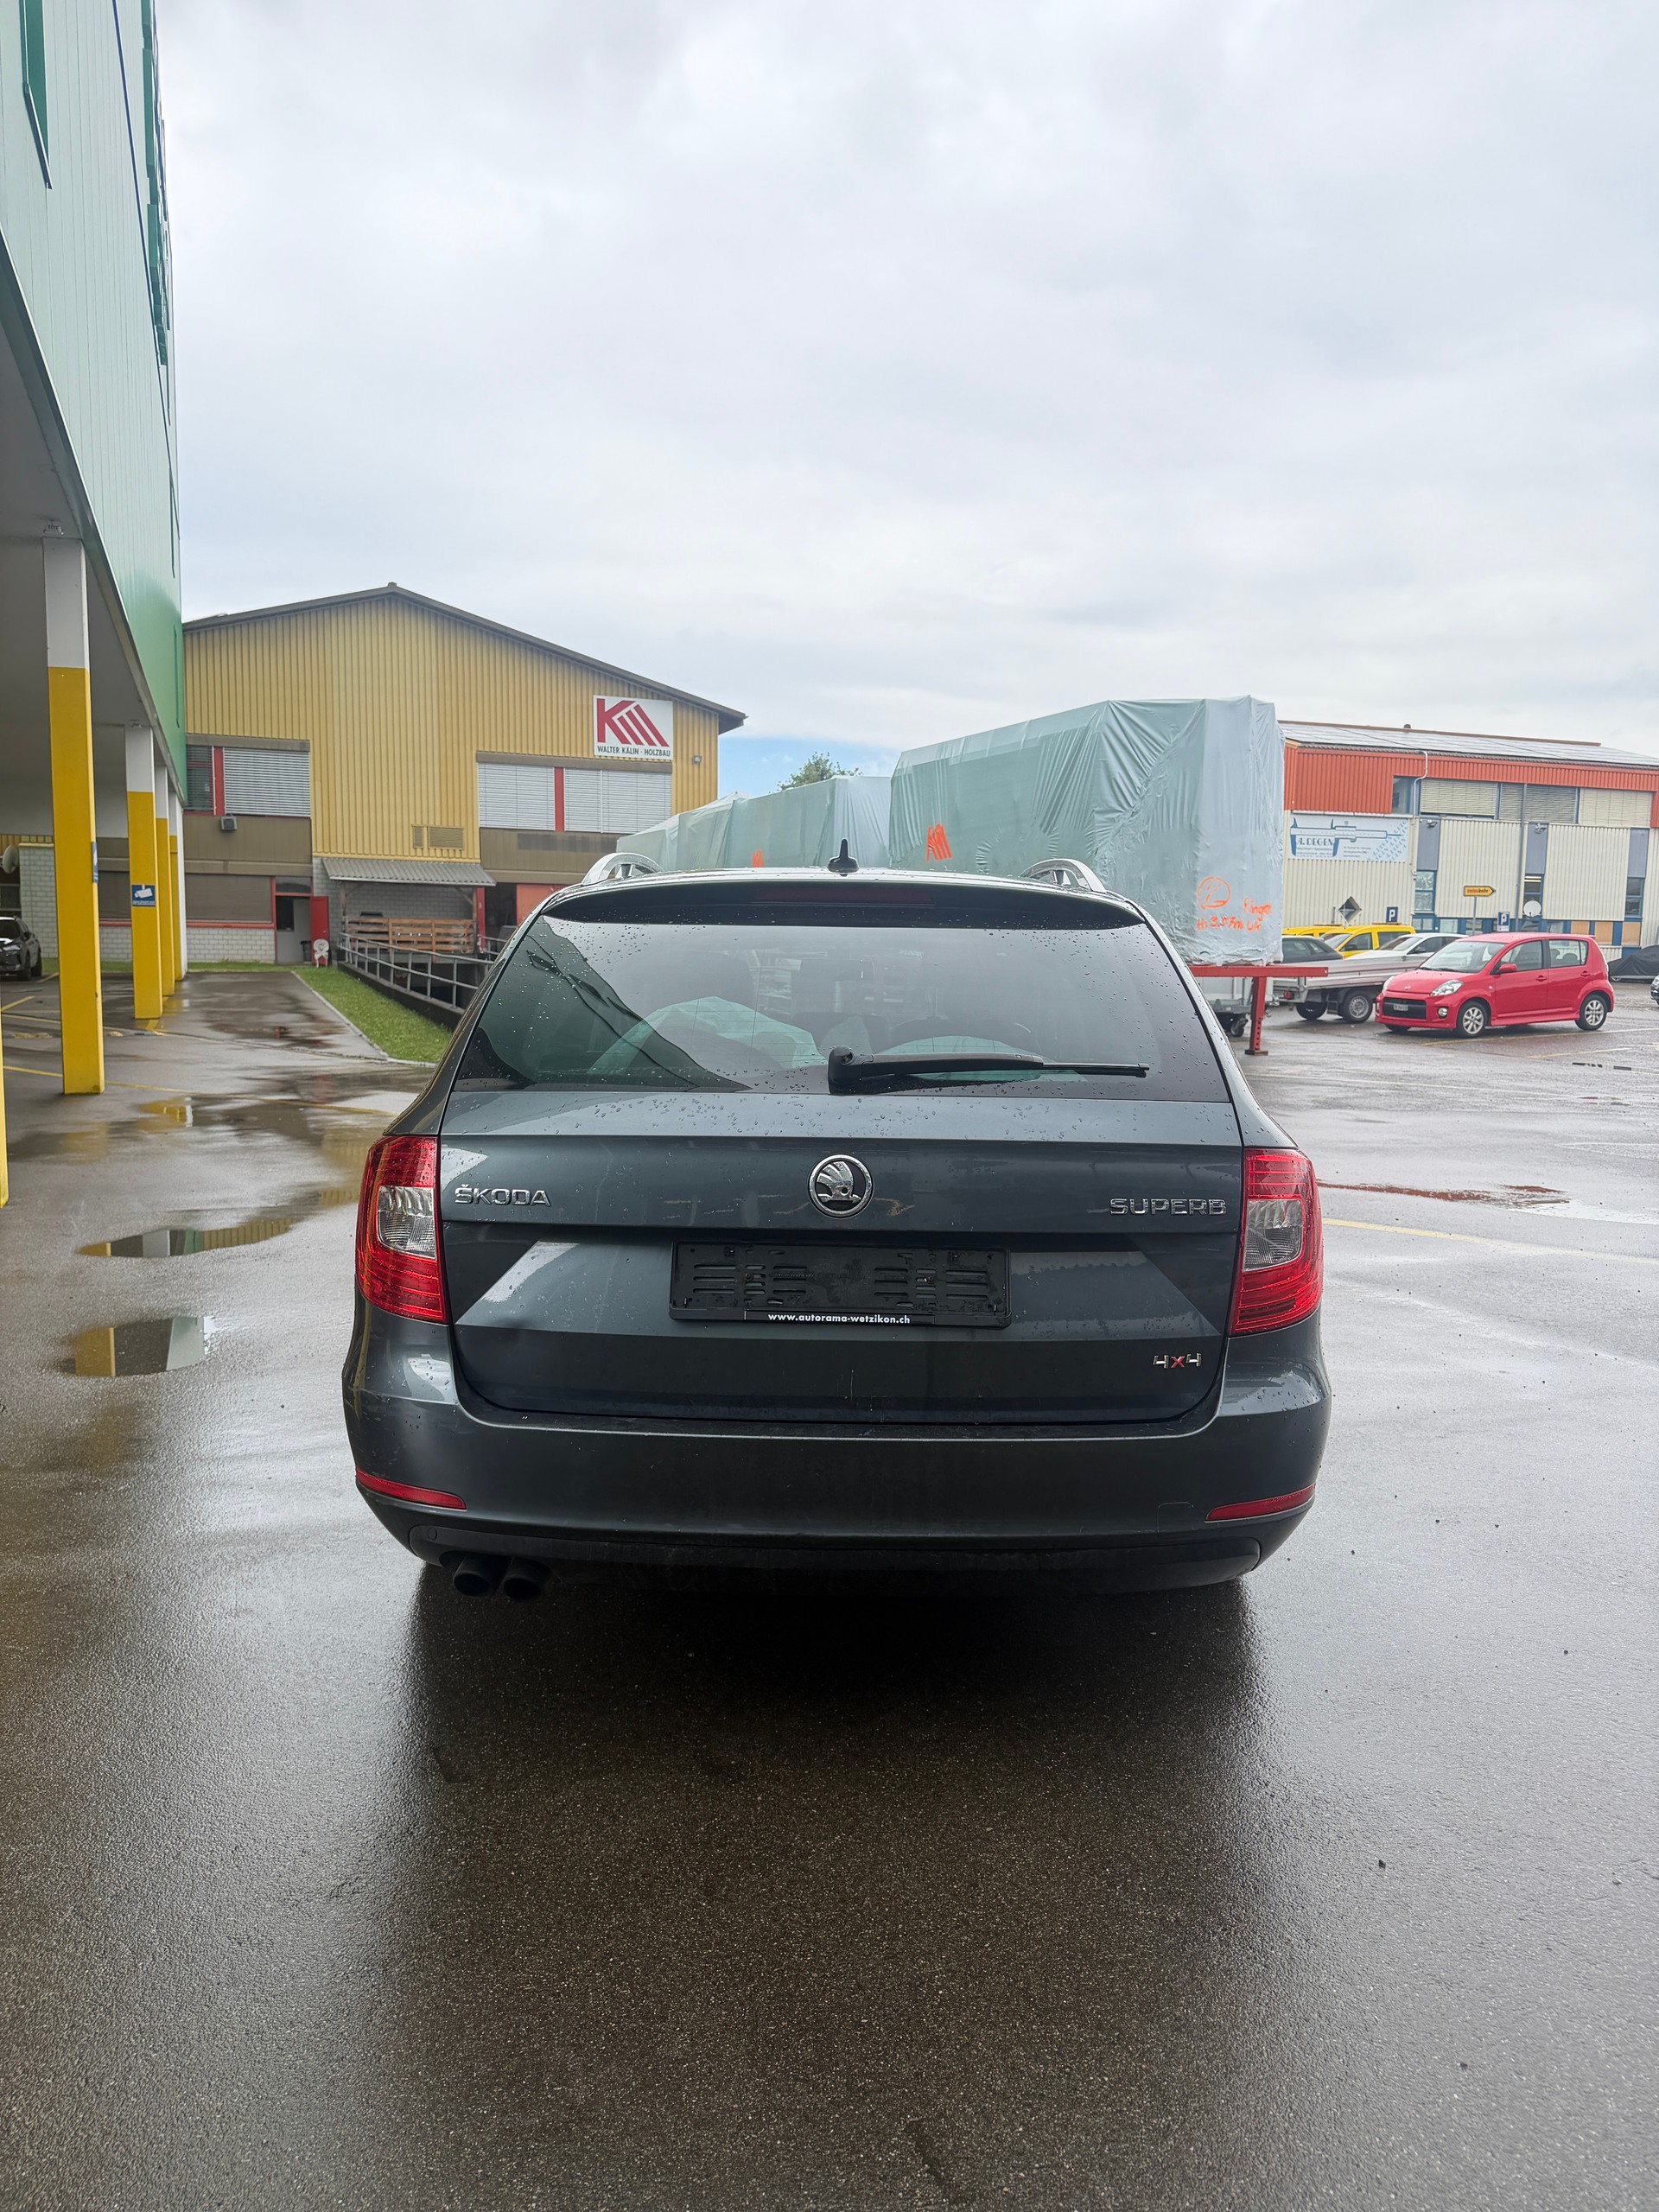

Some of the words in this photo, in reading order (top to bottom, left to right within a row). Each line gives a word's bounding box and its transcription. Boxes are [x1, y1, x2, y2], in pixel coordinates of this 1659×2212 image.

[597, 746, 620, 755] WALTER
[622, 747, 639, 755] KÄLIN
[644, 748, 671, 757] HOLZBAU
[1306, 837, 1333, 846] DEGEN
[1389, 909, 1395, 922] P
[1500, 913, 1507, 925] P
[454, 1184, 551, 1206] ŠKODA
[1109, 1198, 1227, 1215] SUPERB
[768, 1313, 911, 1324] www.autorama-wetzikon.ch
[1153, 1353, 1202, 1369] 4x4
